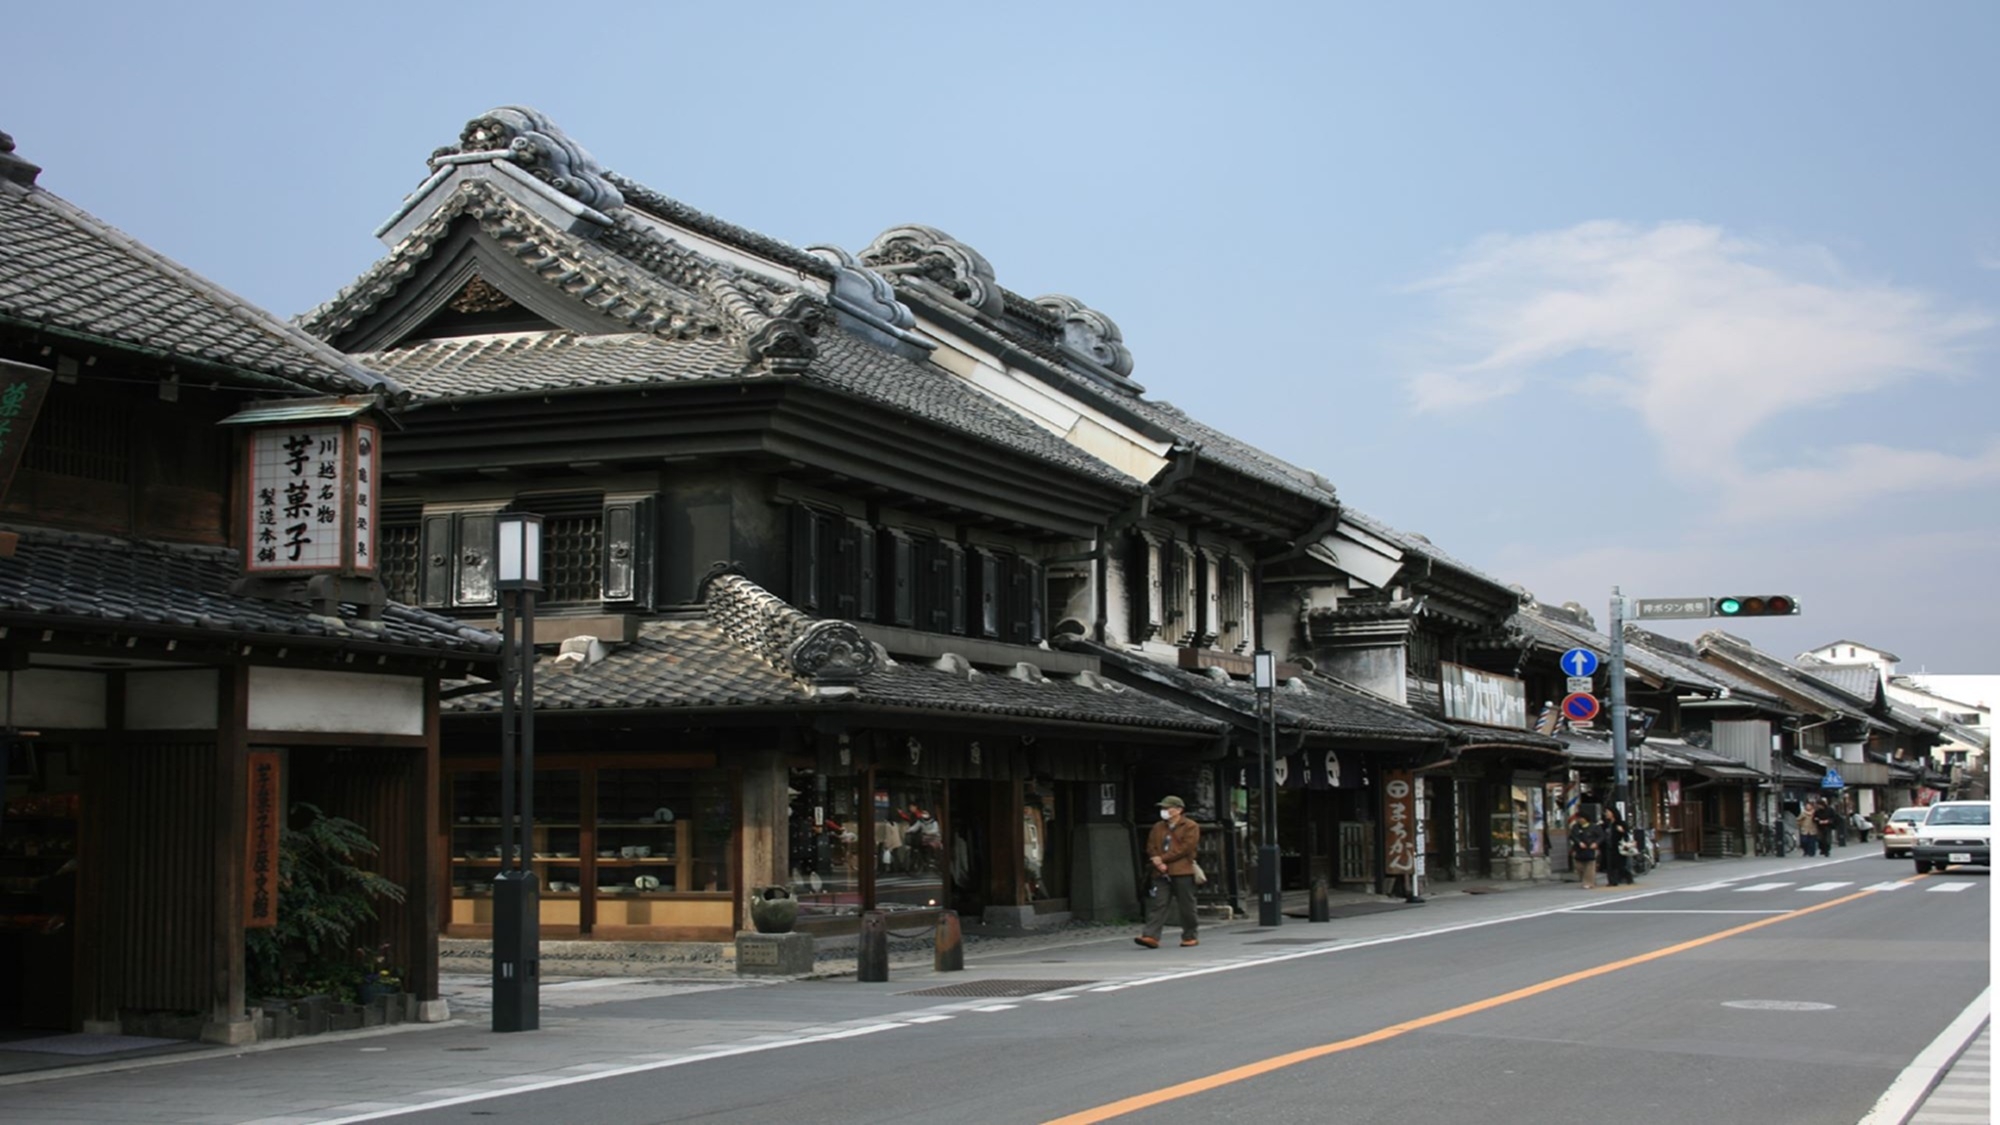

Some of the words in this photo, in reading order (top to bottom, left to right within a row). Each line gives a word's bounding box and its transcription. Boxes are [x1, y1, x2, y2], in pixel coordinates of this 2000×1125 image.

[283, 435, 314, 562] 芋菓子
[317, 437, 338, 524] 川越名物
[1388, 801, 1414, 871] まちかん
